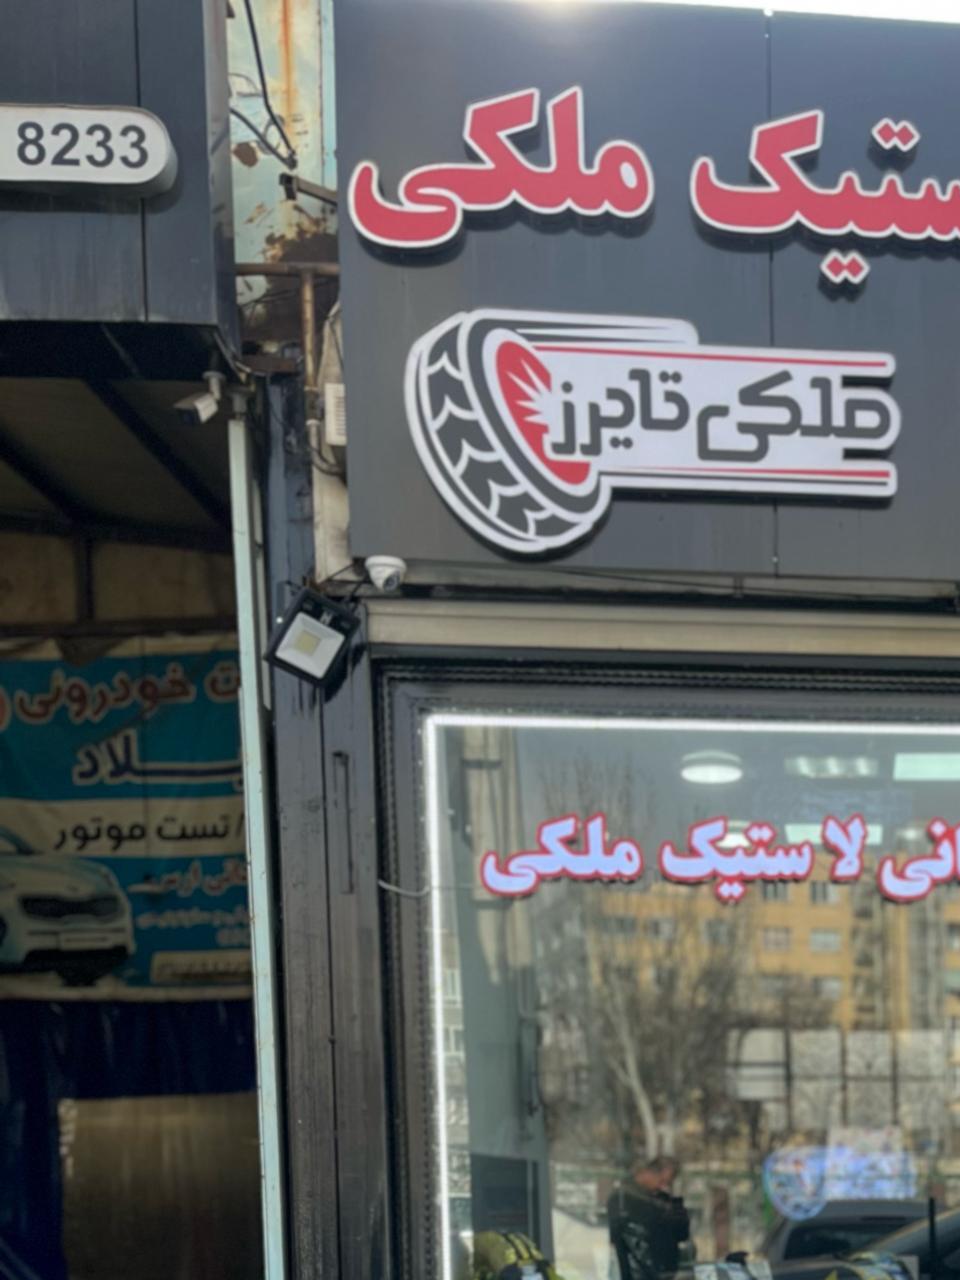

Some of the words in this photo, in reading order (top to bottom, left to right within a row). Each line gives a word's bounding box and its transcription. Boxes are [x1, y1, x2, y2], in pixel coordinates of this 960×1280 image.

[17, 121, 148, 169] 8233
[348, 85, 654, 249] ملکی
[551, 368, 690, 457] تایرز
[697, 371, 892, 463] ملکی
[55, 816, 146, 850] موتور
[156, 814, 229, 841] تست
[482, 814, 642, 897] ملکی
